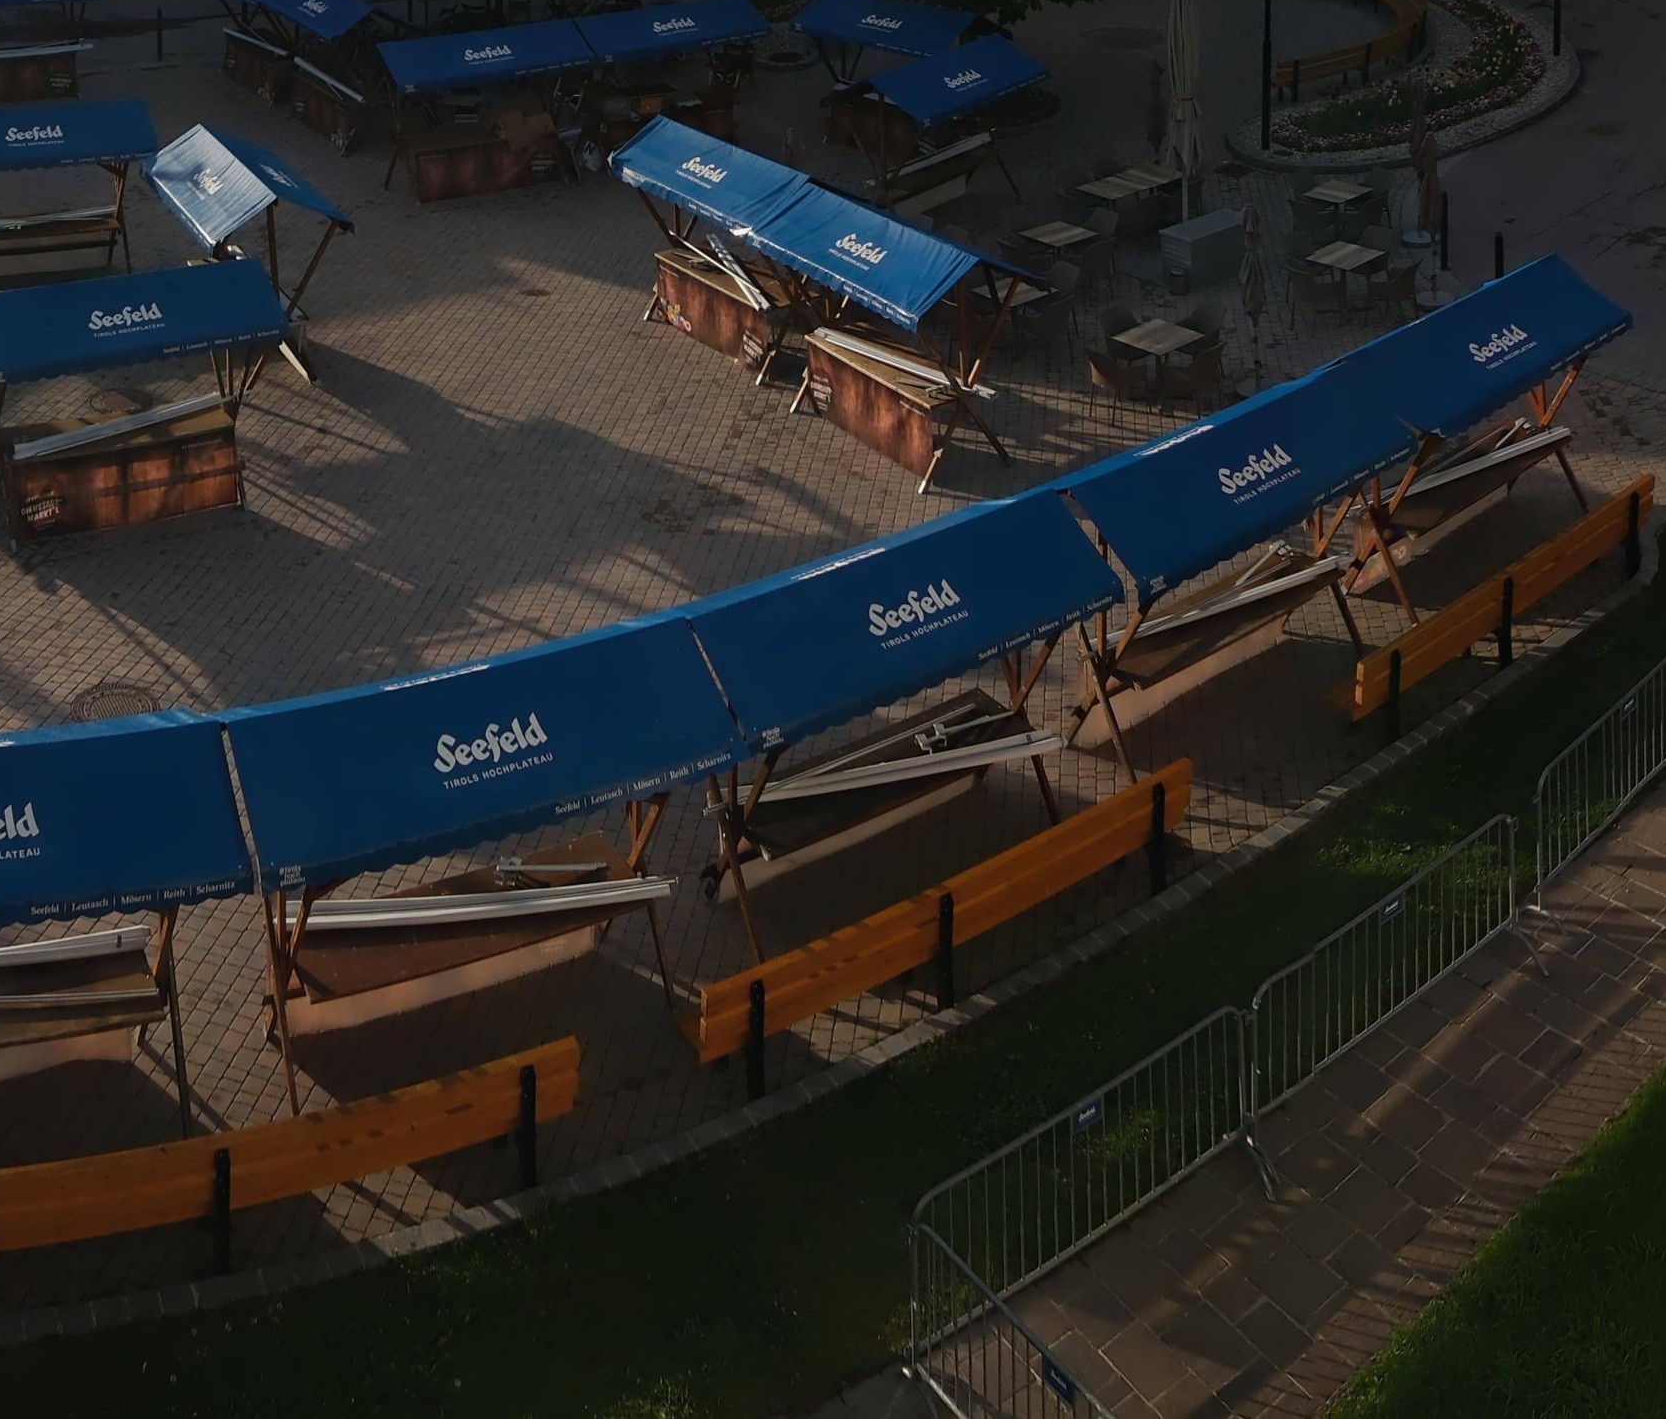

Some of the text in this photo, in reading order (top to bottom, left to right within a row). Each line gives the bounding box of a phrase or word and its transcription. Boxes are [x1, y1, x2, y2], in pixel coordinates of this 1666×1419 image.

[653, 17, 695, 33] Seefeld
[861, 14, 903, 30] Seefeld
[464, 44, 512, 61] Seefeld
[5, 125, 64, 142] Seefeld
[682, 156, 728, 183] Seefeld
[836, 233, 888, 264] Seefeld
[88, 303, 162, 331] Seefeld
[1469, 324, 1528, 363] Seefeld
[1218, 443, 1292, 495] Seefeld
[869, 578, 960, 637] Seefeld
[881, 632, 911, 651] TIROLS
[433, 711, 549, 774] Seefeld
[443, 752, 554, 790] TIROLS HOCHPLATEAU
[555, 799, 581, 816] Seefeld
[590, 787, 624, 804] Leutasch
[669, 766, 689, 780] Reith
[696, 752, 732, 772] Scharnitz
[30, 903, 60, 916] Seefeld
[71, 897, 109, 912] Leutasch
[164, 886, 187, 900] Reith
[196, 879, 237, 895] Scharnitz
